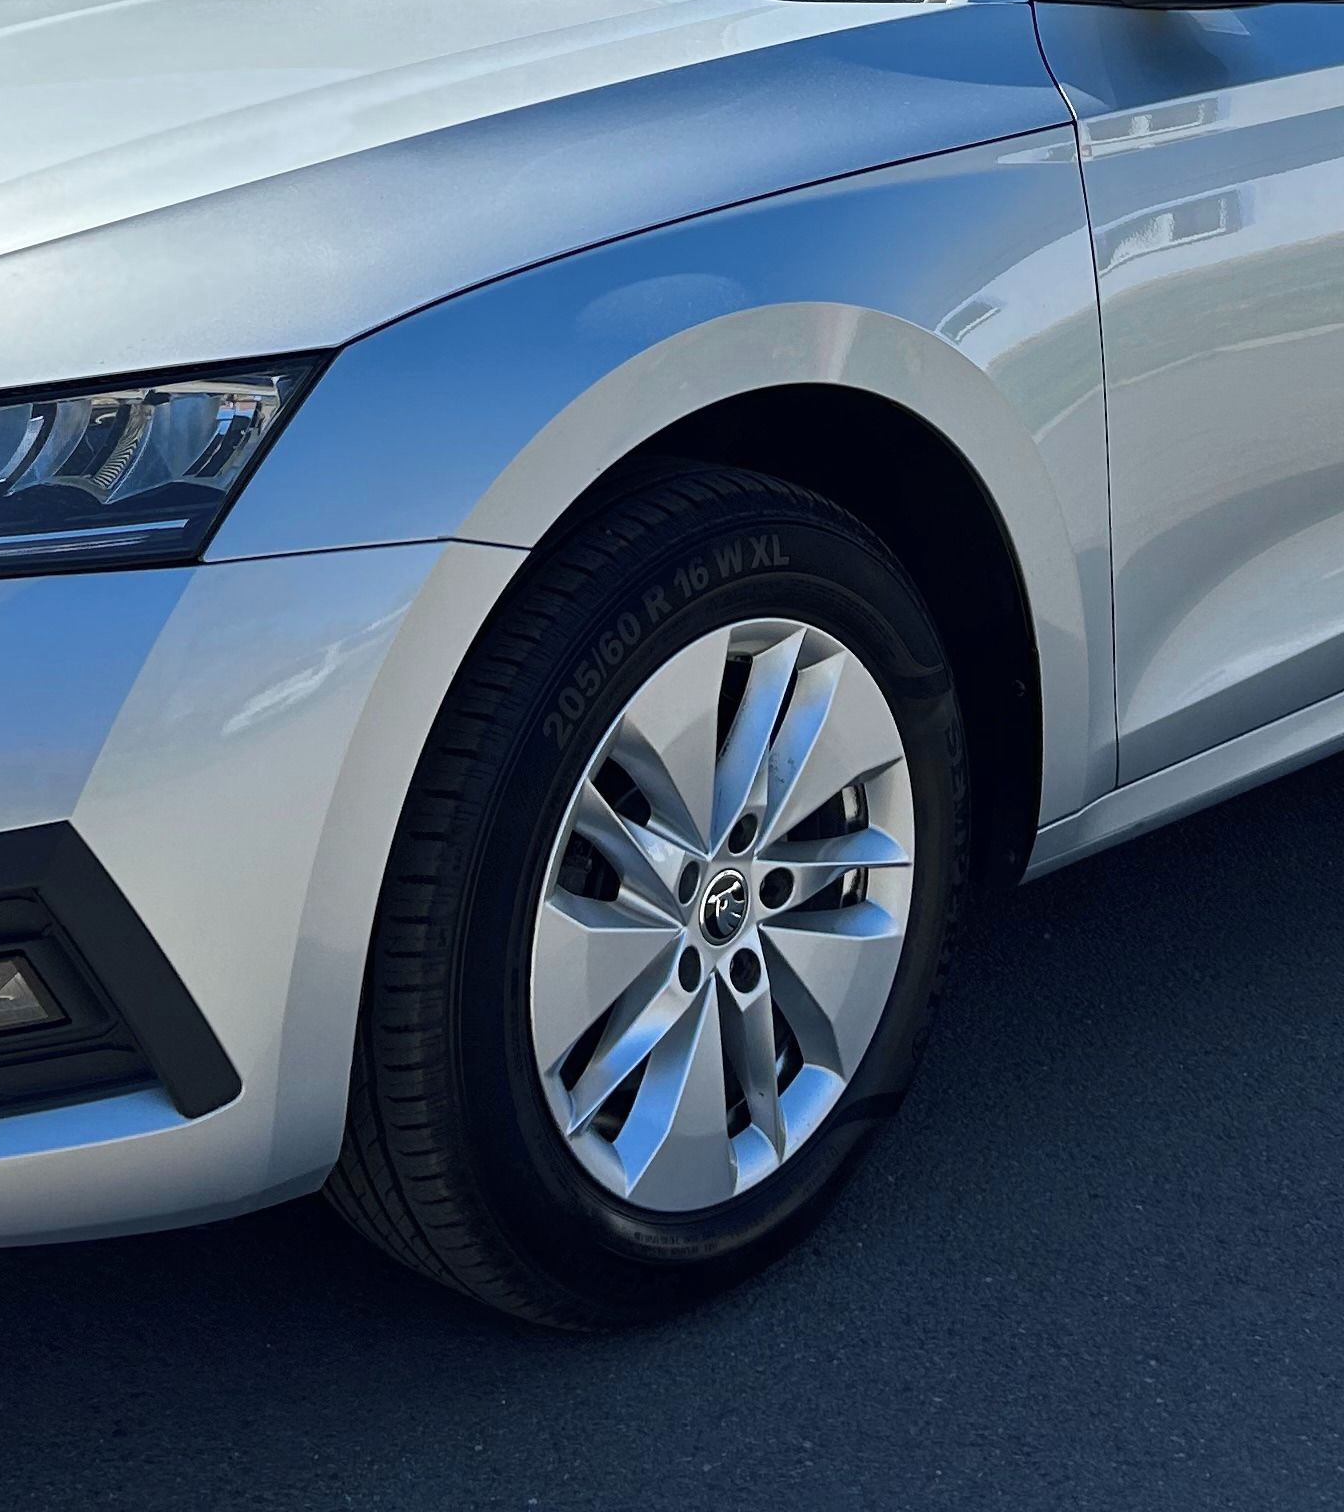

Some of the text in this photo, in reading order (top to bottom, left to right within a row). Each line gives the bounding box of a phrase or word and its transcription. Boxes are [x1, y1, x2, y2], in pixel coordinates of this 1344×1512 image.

[542, 534, 791, 751] 205/60 R 16 W XL
